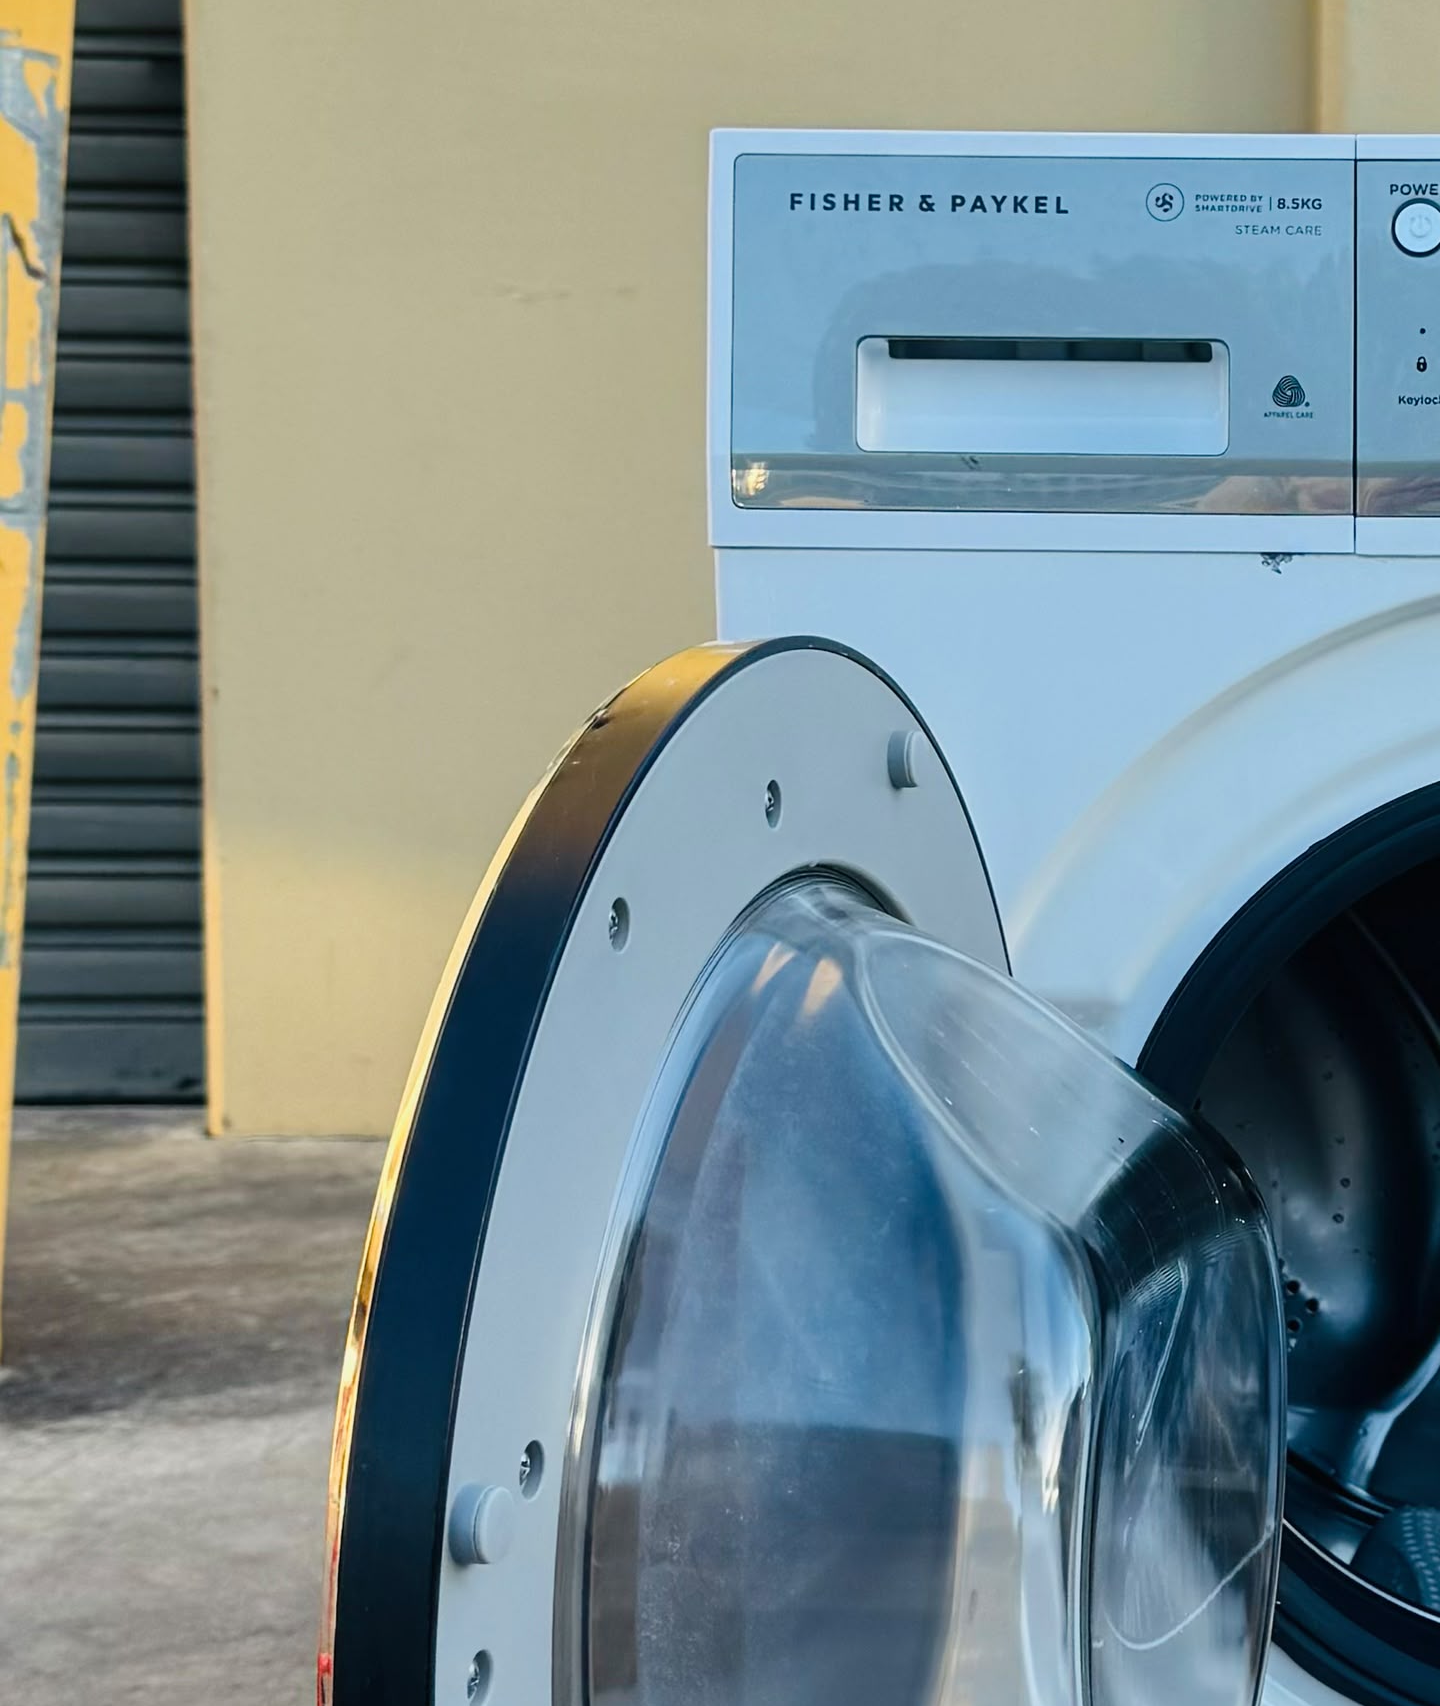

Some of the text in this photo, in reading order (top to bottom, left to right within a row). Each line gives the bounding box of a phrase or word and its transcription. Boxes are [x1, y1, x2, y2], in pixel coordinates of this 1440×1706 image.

[789, 193, 1069, 214] FISHER & PAYKEL
[1194, 194, 1264, 203] POWERED BY
[1276, 198, 1323, 210] 8.5KG
[1235, 225, 1322, 237] STEAM CARE
